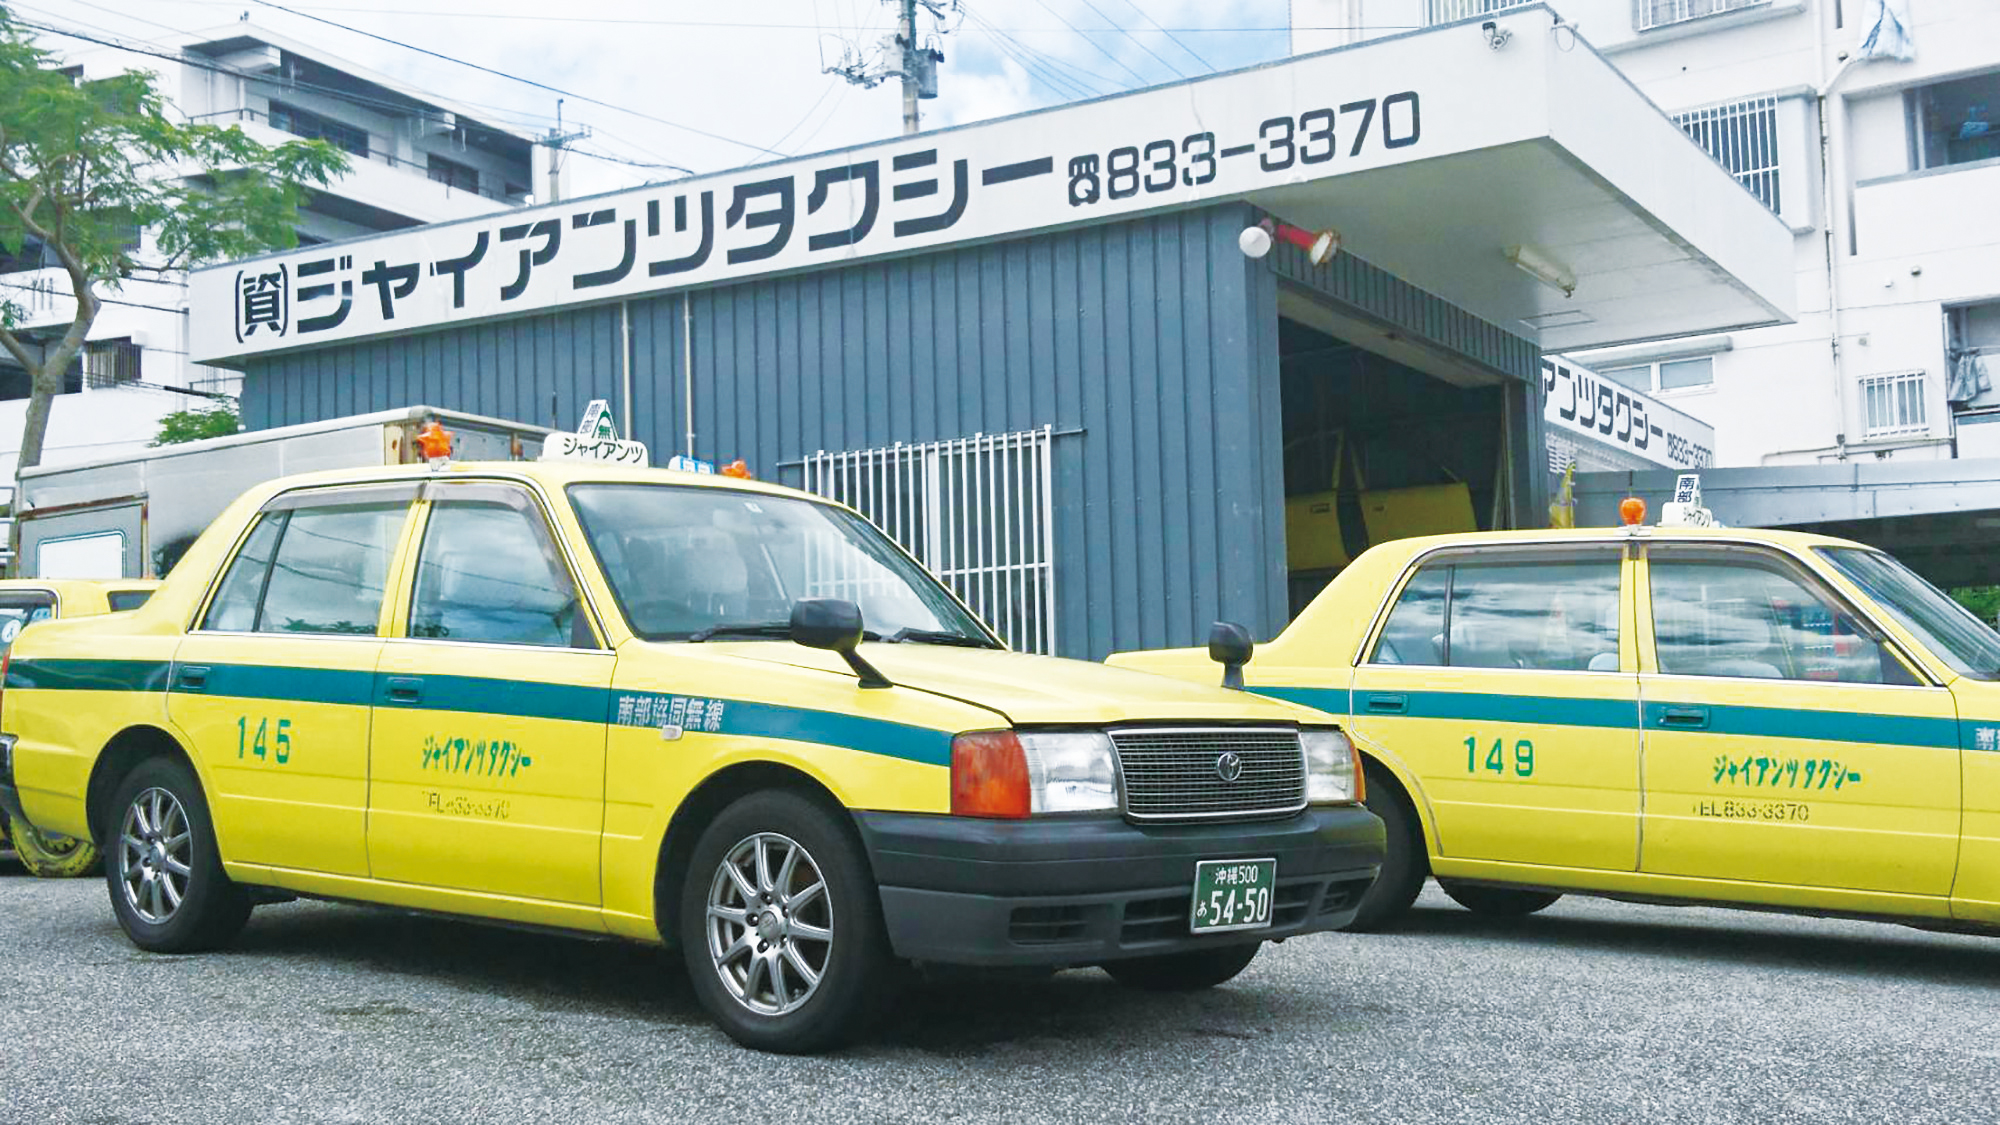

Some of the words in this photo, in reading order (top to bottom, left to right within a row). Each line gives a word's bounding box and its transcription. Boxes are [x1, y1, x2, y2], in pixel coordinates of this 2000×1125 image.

[1107, 90, 1421, 201] 833-3370
[563, 437, 644, 463] ジャイアンツ
[1677, 476, 1696, 503] 南部
[238, 715, 291, 764] 145
[1463, 736, 1533, 777] 149
[1975, 726, 2000, 751] 南
[1209, 887, 1268, 925] 54-50
